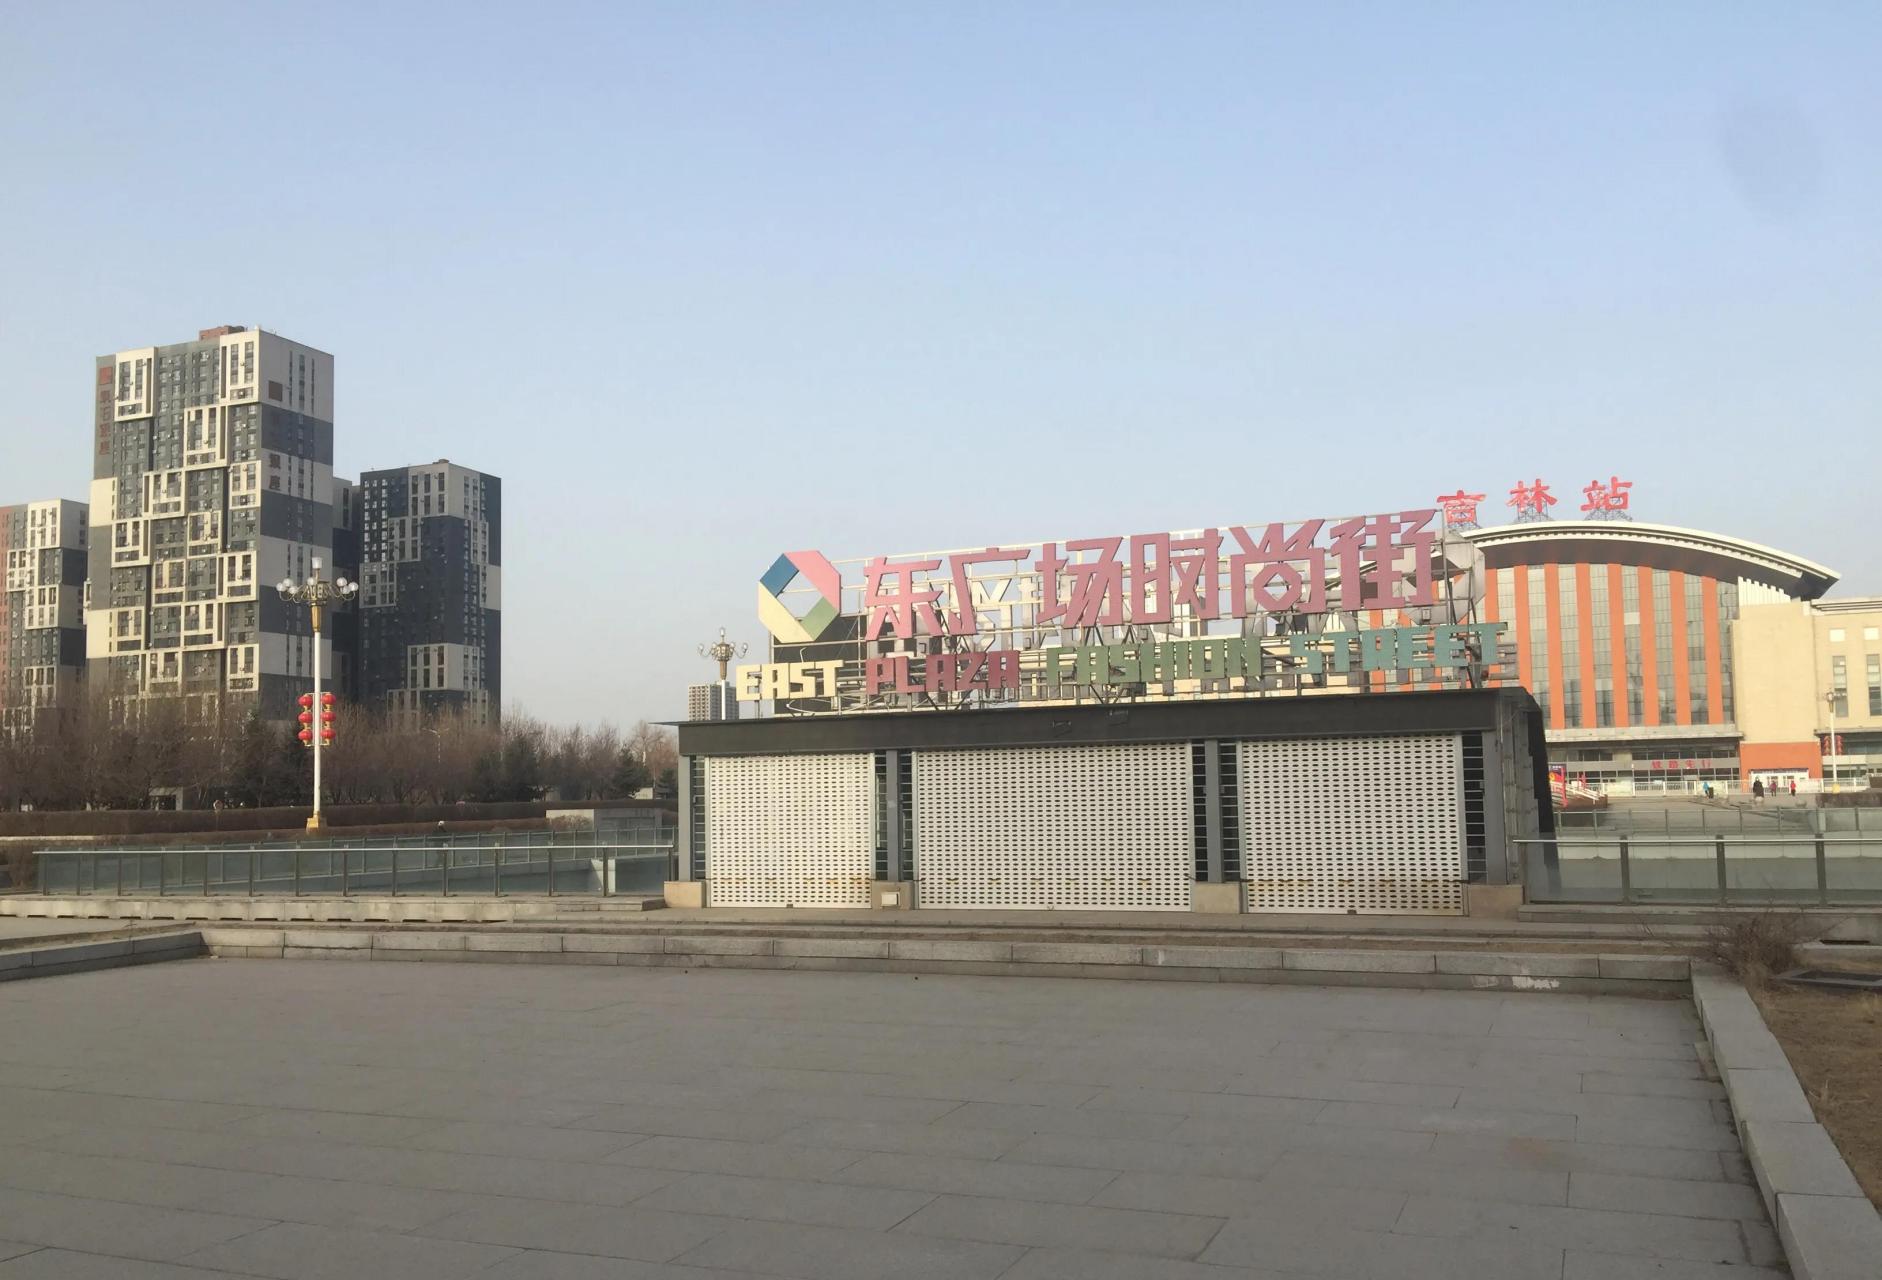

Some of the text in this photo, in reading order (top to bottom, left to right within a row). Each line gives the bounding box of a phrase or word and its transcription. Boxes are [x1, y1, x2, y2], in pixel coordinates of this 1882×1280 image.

[864, 509, 1437, 641] 东广场时尚街
[736, 622, 1507, 700] EAST PLAZA FASHION STREET
